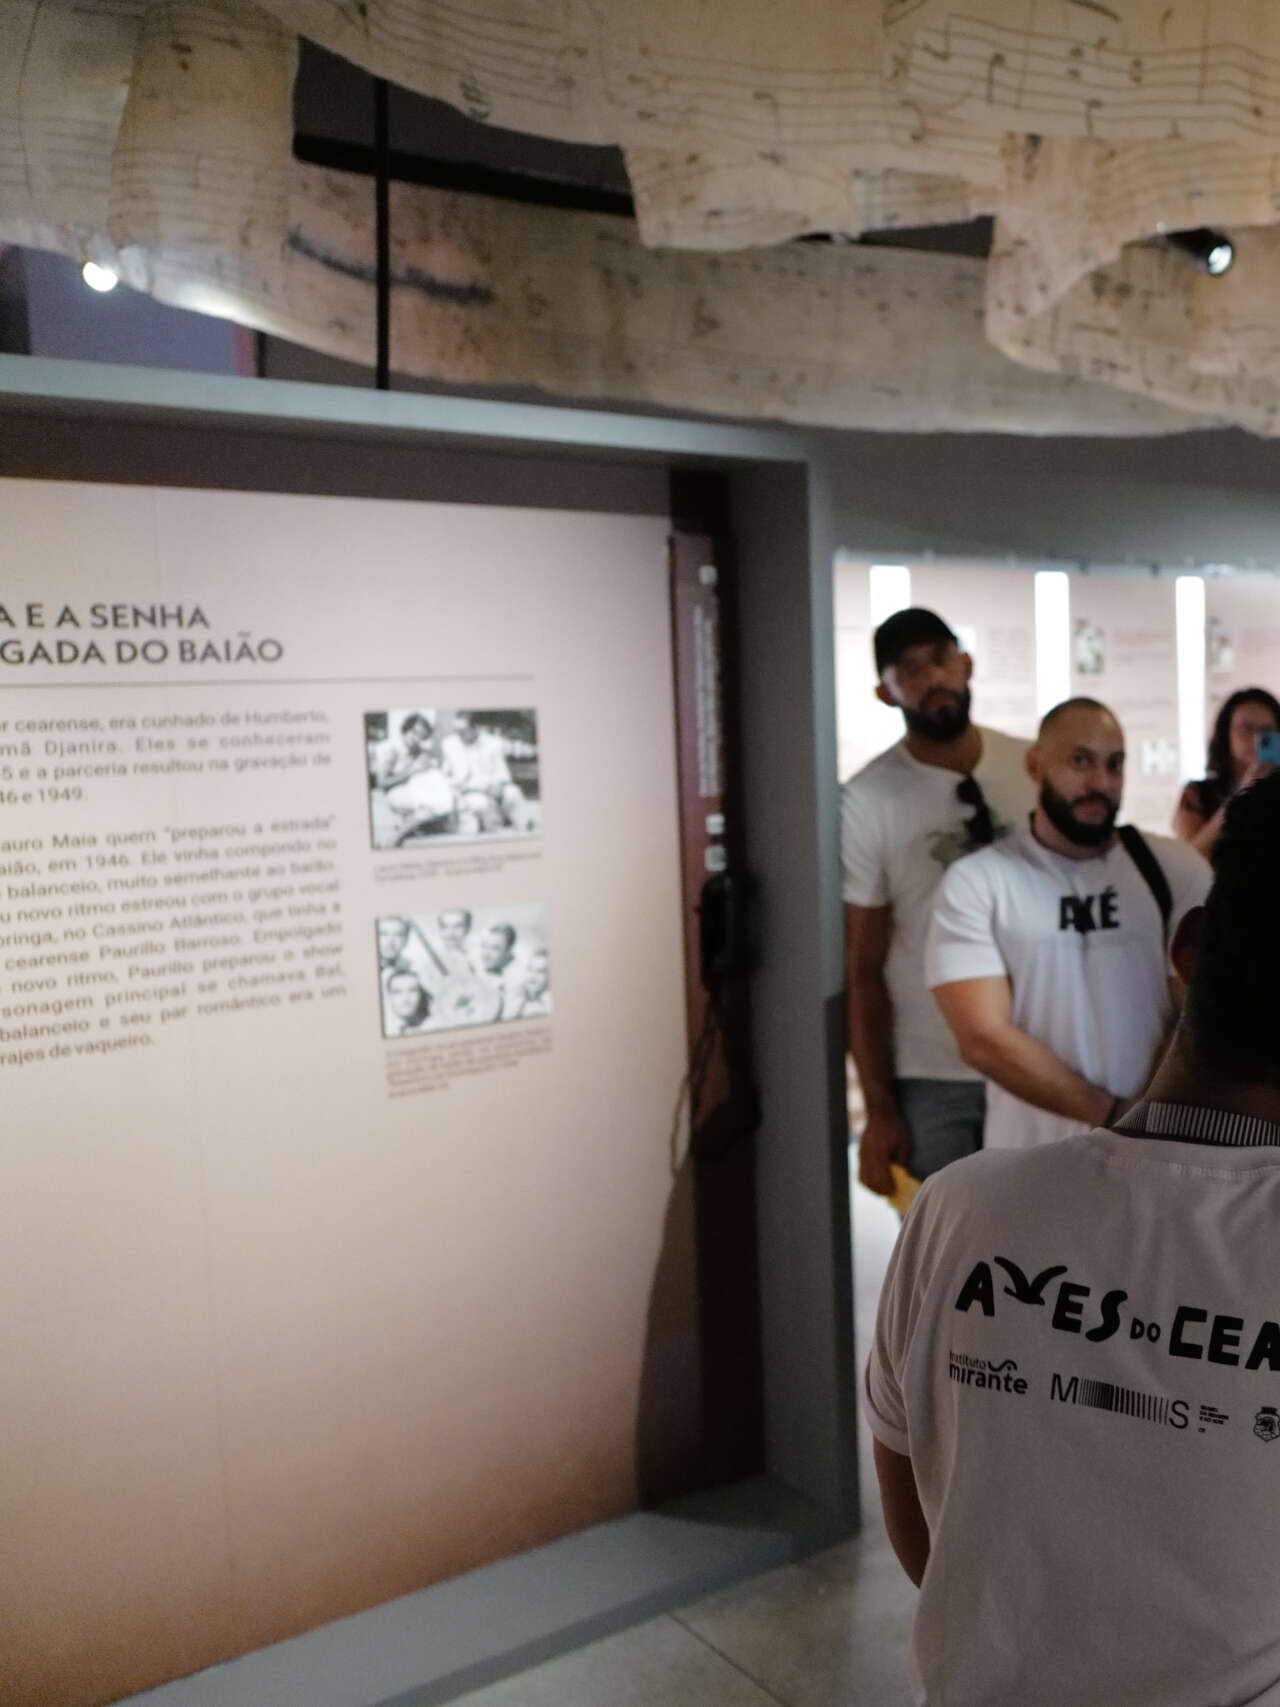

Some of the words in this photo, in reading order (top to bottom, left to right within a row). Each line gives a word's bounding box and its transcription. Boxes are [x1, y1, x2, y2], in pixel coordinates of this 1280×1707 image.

[26, 604, 44, 628] E
[56, 604, 80, 628] A
[90, 604, 210, 628] SENHA
[0, 640, 106, 665] GADA
[116, 640, 168, 664] DO
[178, 631, 284, 663] BAIÃO
[15, 717, 104, 733] cearense,
[109, 716, 136, 731] era
[141, 711, 216, 730] cunhado
[220, 710, 240, 726] de
[136, 735, 176, 754] Eles
[187, 738, 208, 750] se
[219, 733, 331, 750] conheceram
[19, 768, 30, 780] e
[37, 768, 47, 779] a
[54, 763, 128, 781] parceria
[133, 758, 204, 776] resultou
[208, 759, 229, 773] na
[233, 754, 307, 775] gravação
[312, 752, 331, 767] de
[22, 792, 33, 804] e
[0, 838, 43, 853] auro
[52, 833, 98, 849] Maia
[105, 831, 156, 850] quem
[254, 823, 264, 834] a
[48, 858, 78, 874] em
[141, 849, 168, 866] Ele
[174, 847, 219, 863] vinha
[225, 839, 311, 859] compondo
[317, 839, 338, 851] no
[7, 879, 102, 899] balanceio,
[107, 873, 158, 891] muito
[163, 865, 260, 887] semelhante
[266, 865, 286, 877] ao
[17, 906, 62, 922] novo
[68, 900, 116, 917] ritmo
[120, 894, 187, 914] estreou
[191, 890, 228, 905] com
[232, 891, 243, 903] o
[248, 885, 295, 905] grupo
[299, 879, 339, 897] vocal
[1058, 884, 1121, 934] AXÉ
[63, 926, 86, 942] no
[92, 918, 164, 938] Cassino
[170, 910, 248, 930] Atlântico,
[253, 907, 282, 924] que
[287, 902, 327, 919] tinha
[5, 950, 90, 970] cearense
[99, 941, 166, 961] Paurillo
[253, 921, 343, 943] Empolgado
[11, 976, 57, 993] novo
[67, 969, 119, 987] ritmo,
[128, 959, 193, 980] Paurillo
[202, 952, 276, 975] preparou
[283, 949, 294, 961] o
[303, 943, 344, 960] show
[2, 995, 94, 1018] sonagem
[105, 981, 187, 1009] principal
[197, 980, 218, 994] se
[227, 967, 305, 991] chamava
[0, 1018, 89, 1042] balanceio
[99, 1016, 110, 1029] e
[120, 1011, 151, 1027] seu
[160, 1005, 188, 1025] par
[197, 992, 281, 1016] romântico
[288, 990, 313, 1004] era
[320, 984, 347, 999] um
[48, 1041, 71, 1059] de
[954, 1256, 1129, 1342] AVES
[1129, 1317, 1161, 1344] DO
[948, 1363, 1029, 1395] mirante
